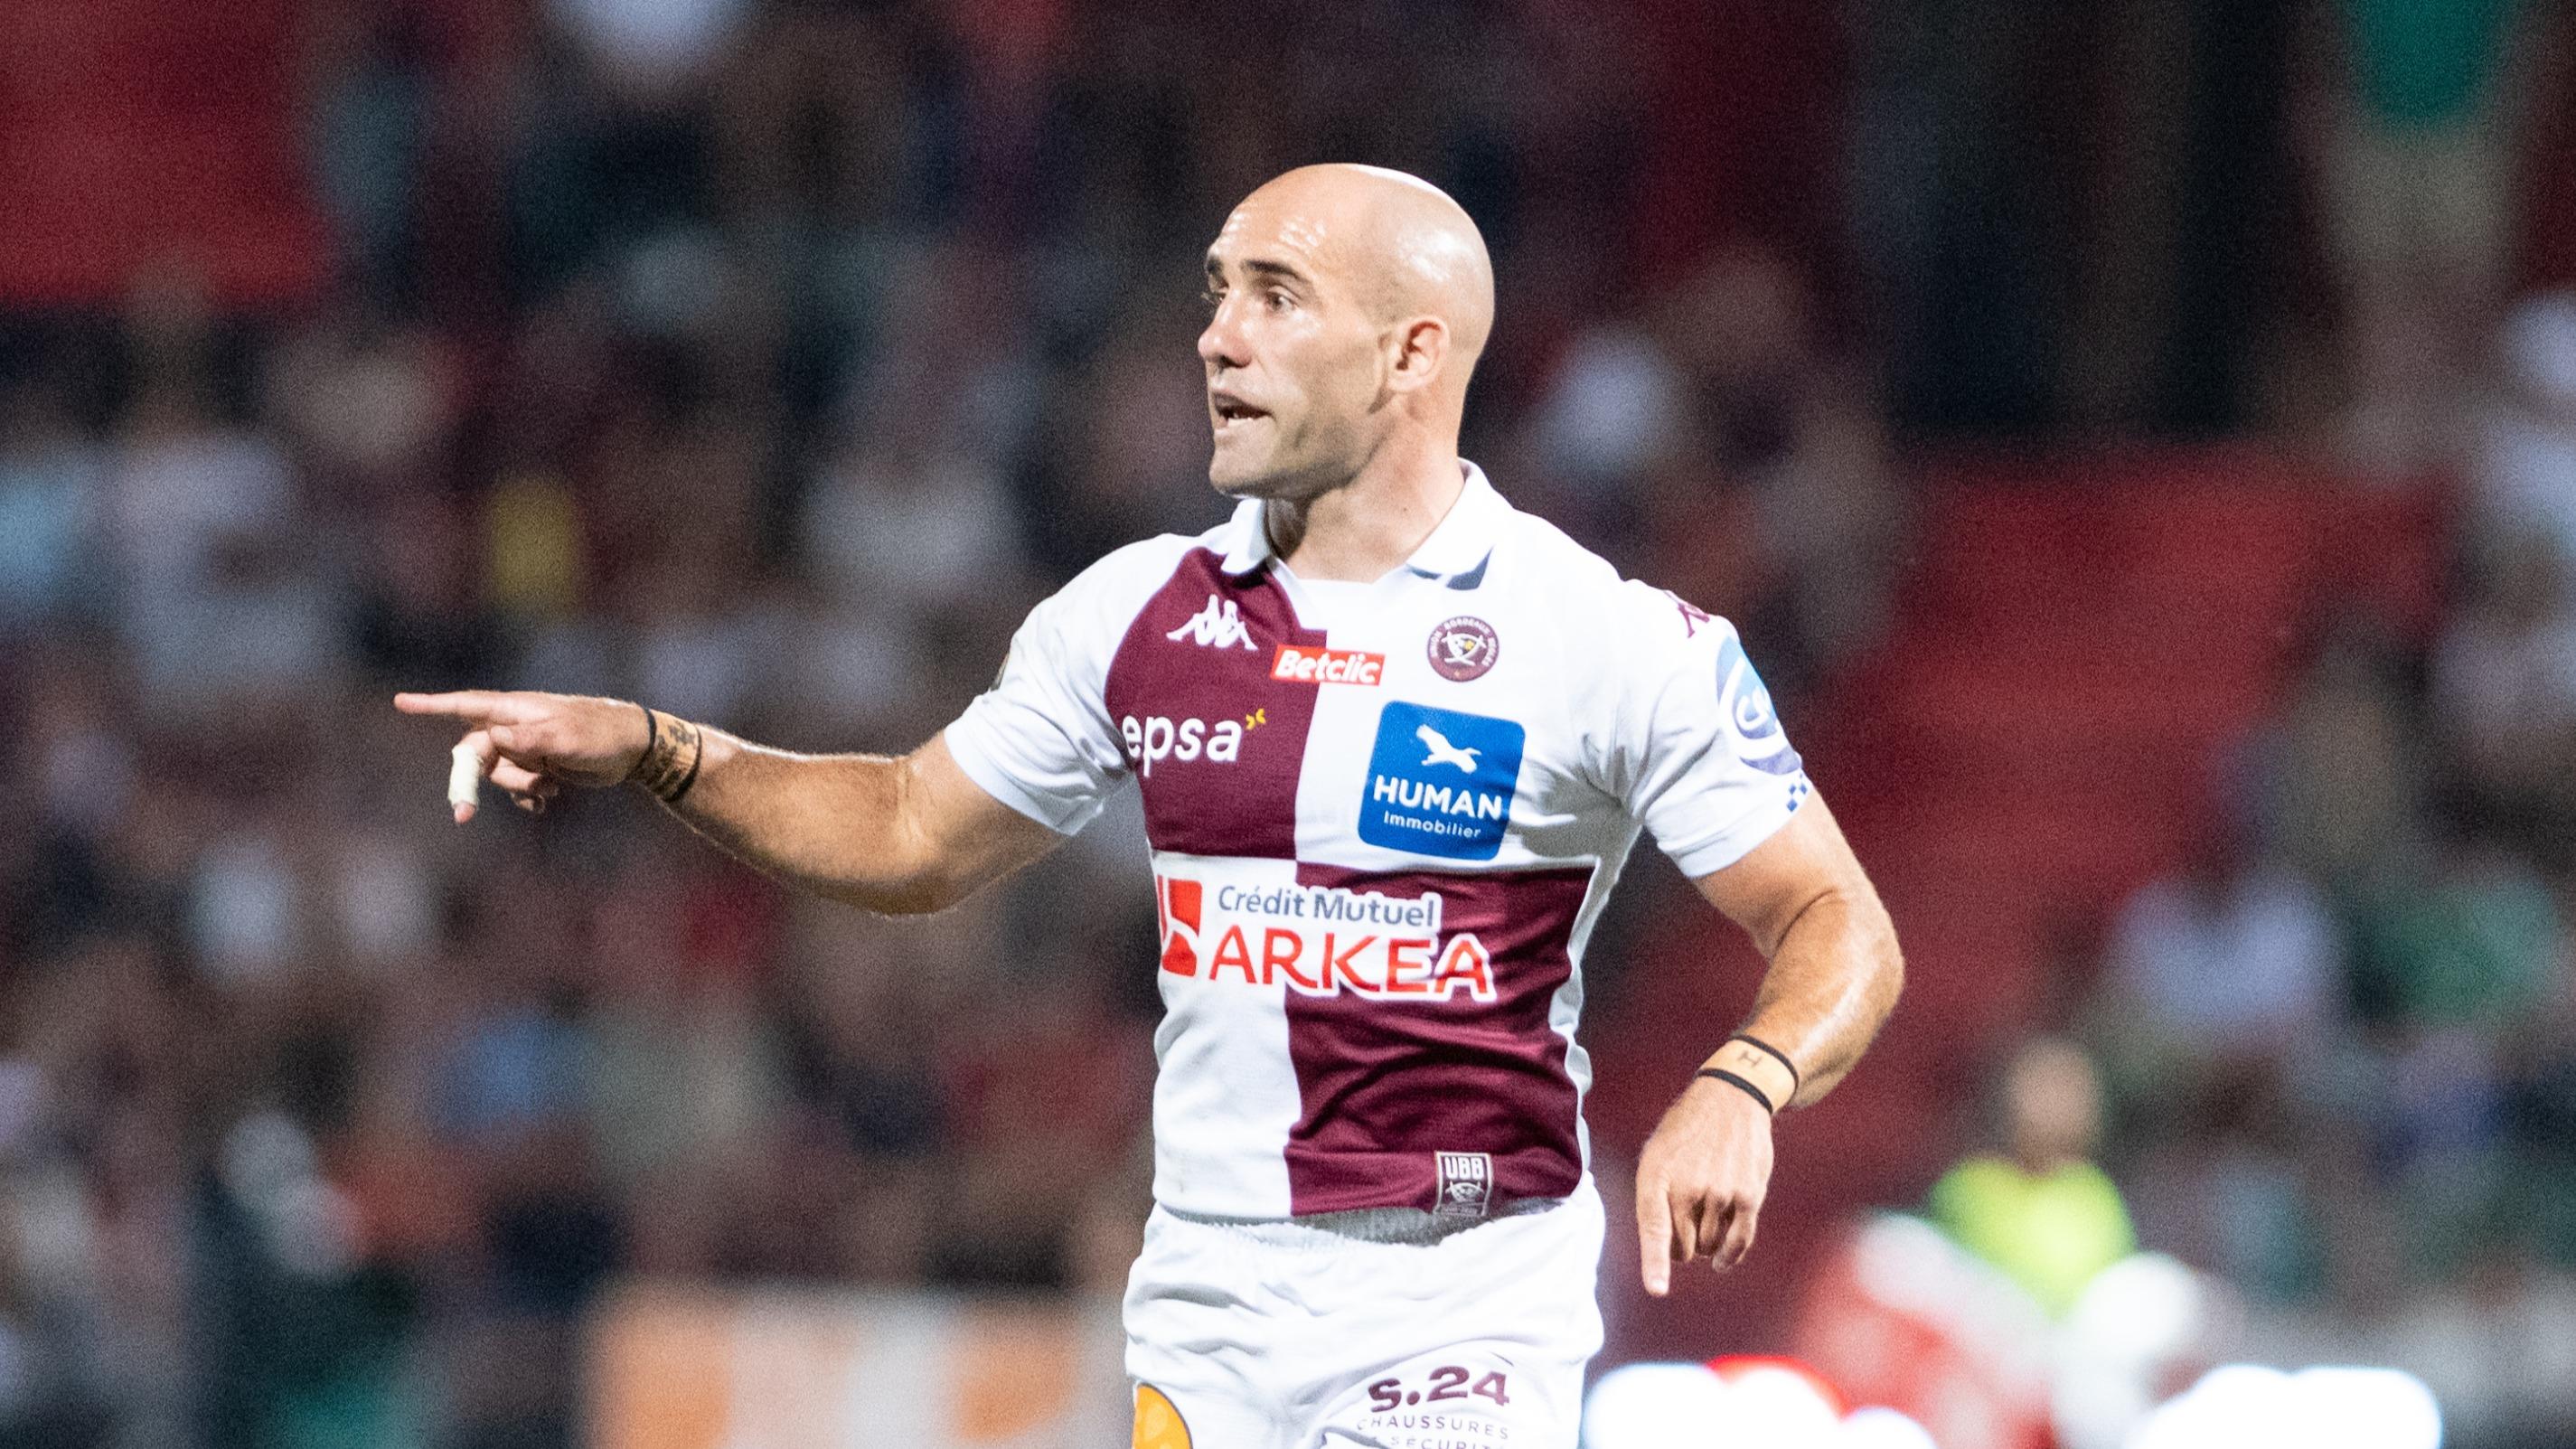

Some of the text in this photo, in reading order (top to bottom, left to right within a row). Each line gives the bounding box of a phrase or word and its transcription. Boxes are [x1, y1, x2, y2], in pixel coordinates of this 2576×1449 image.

[1274, 649, 1381, 683] Betclic
[1122, 715, 1242, 777] epsa
[1373, 775, 1502, 821] HUMAN
[1383, 811, 1482, 838] Immobilier
[1218, 885, 1434, 927] Crédit Mutuel
[1208, 924, 1489, 993] ARKEA
[1444, 1156, 1484, 1181] UBB
[1357, 1415, 1509, 1440] CHAUSSURES
